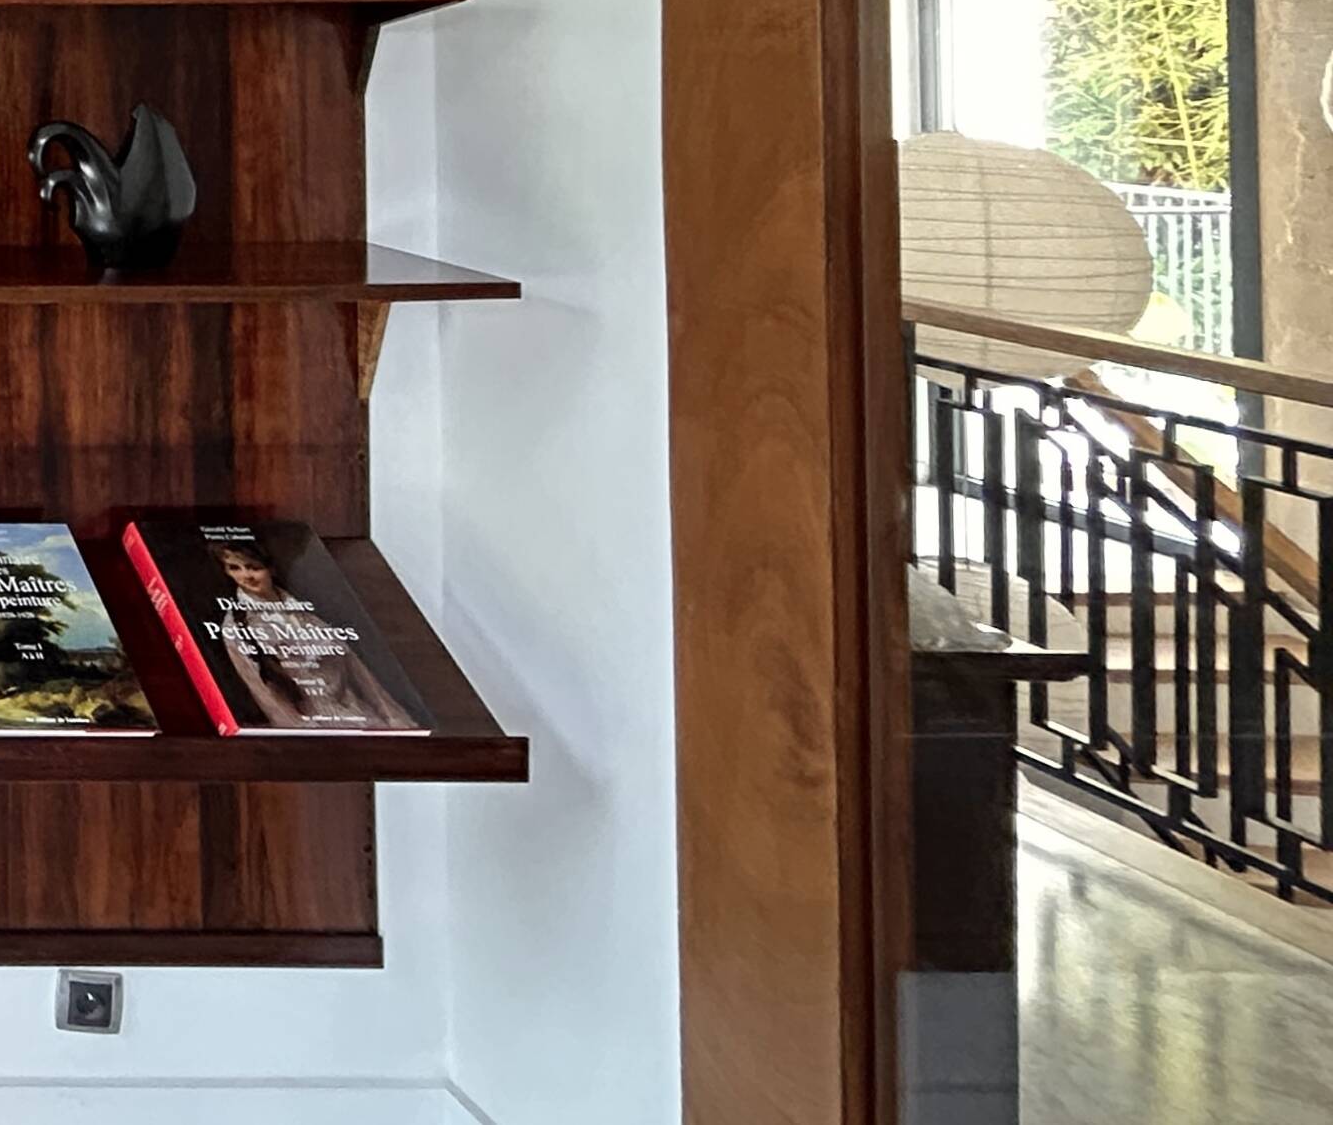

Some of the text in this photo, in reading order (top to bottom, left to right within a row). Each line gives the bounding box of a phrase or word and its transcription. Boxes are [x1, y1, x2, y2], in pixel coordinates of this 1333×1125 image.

[216, 597, 315, 612] Dictionnaire
[203, 621, 360, 641] Petits Maîtres
[238, 642, 346, 659] de la peinture
